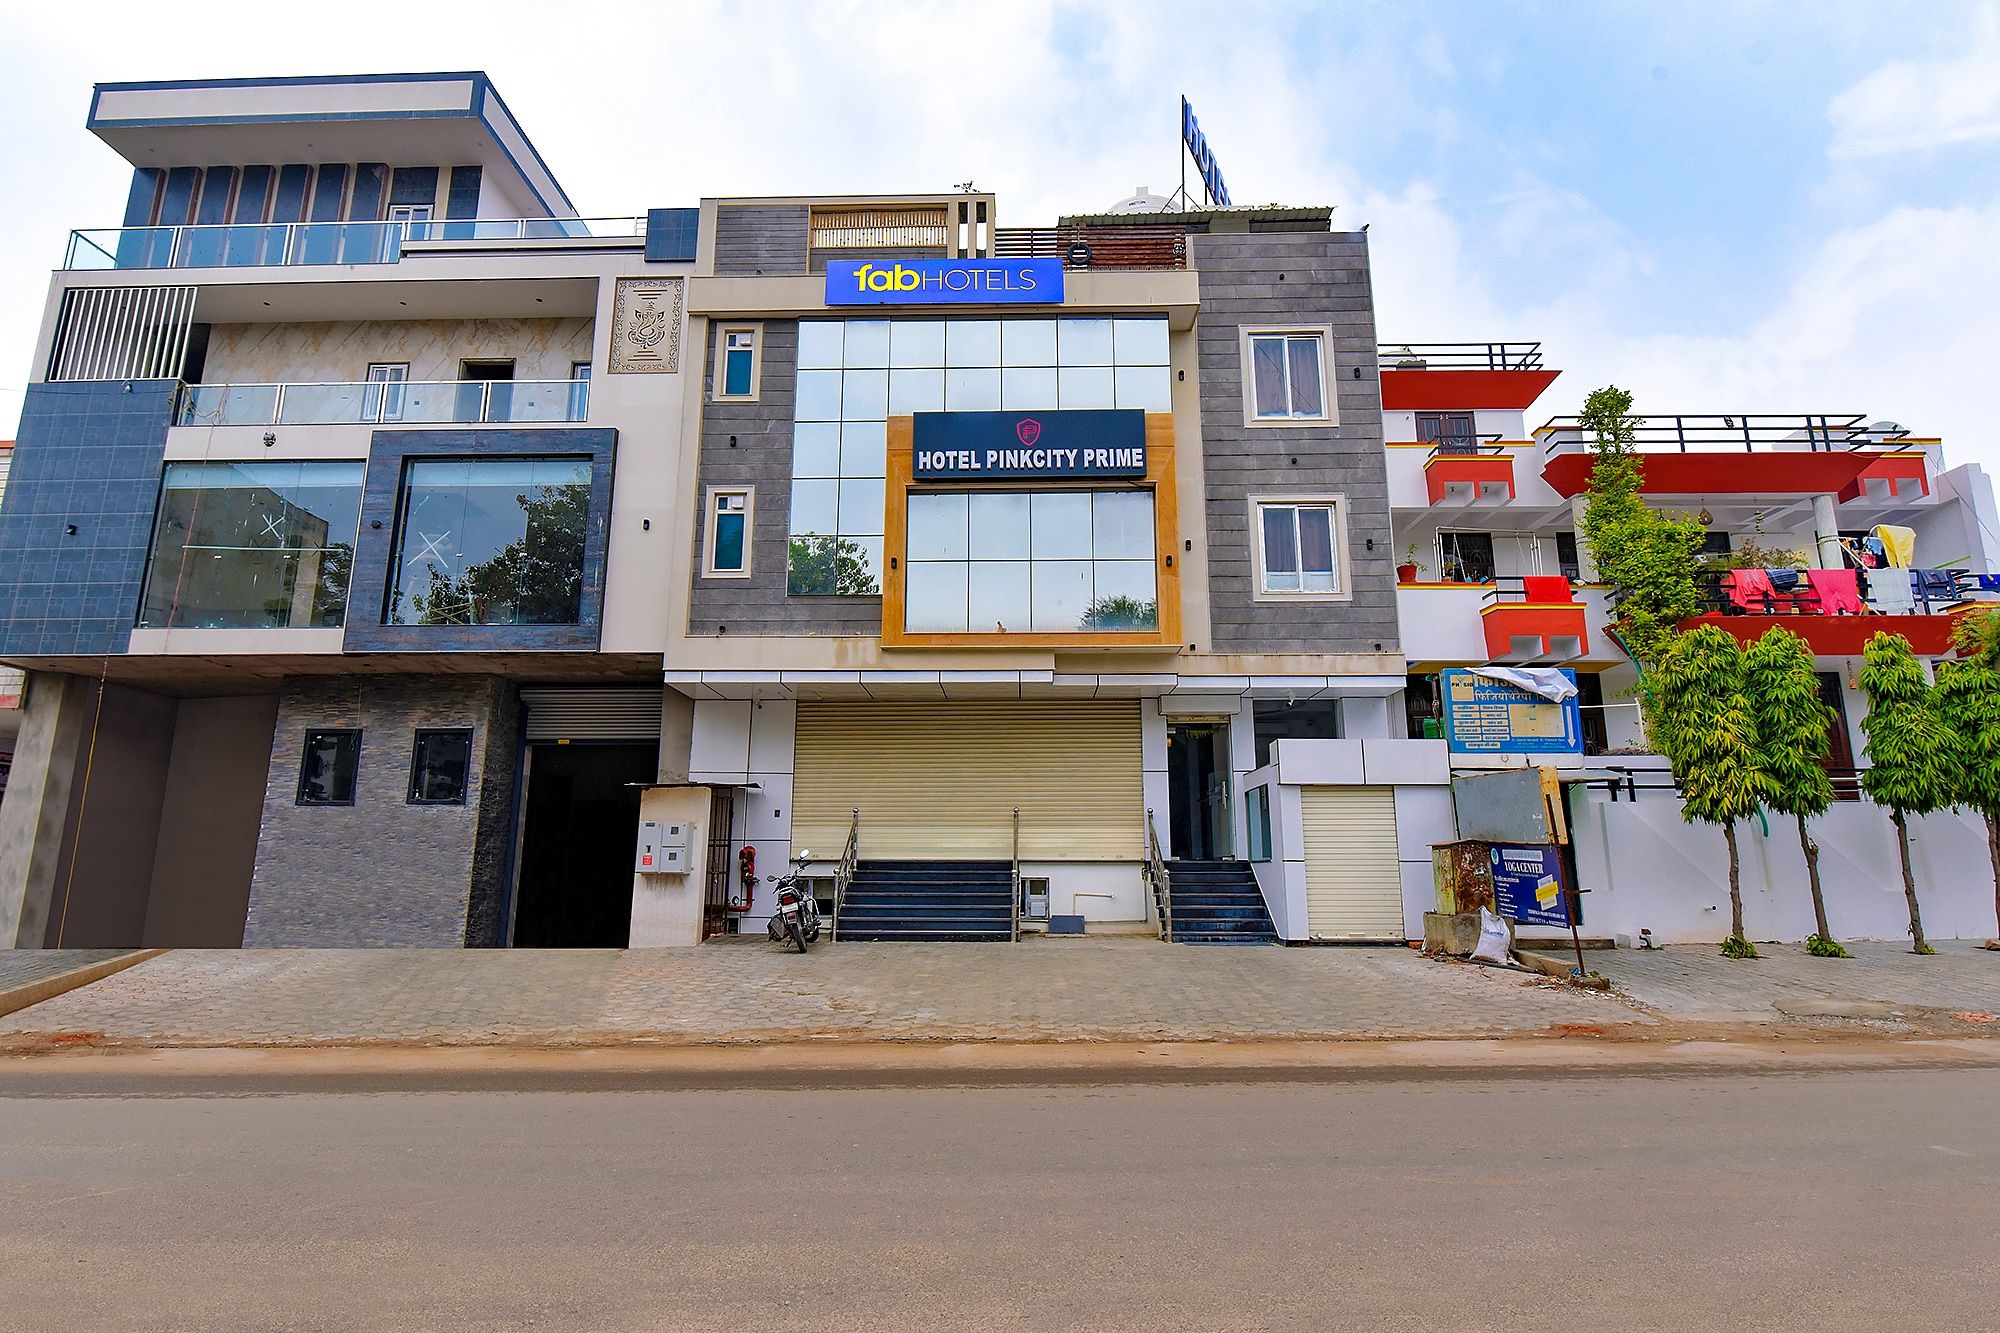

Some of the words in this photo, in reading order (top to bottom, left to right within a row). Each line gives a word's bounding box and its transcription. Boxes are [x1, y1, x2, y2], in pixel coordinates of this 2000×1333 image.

[918, 450, 981, 470] HOTEL
[986, 449, 1078, 470] PINKCITY
[1083, 448, 1144, 469] PRIME
